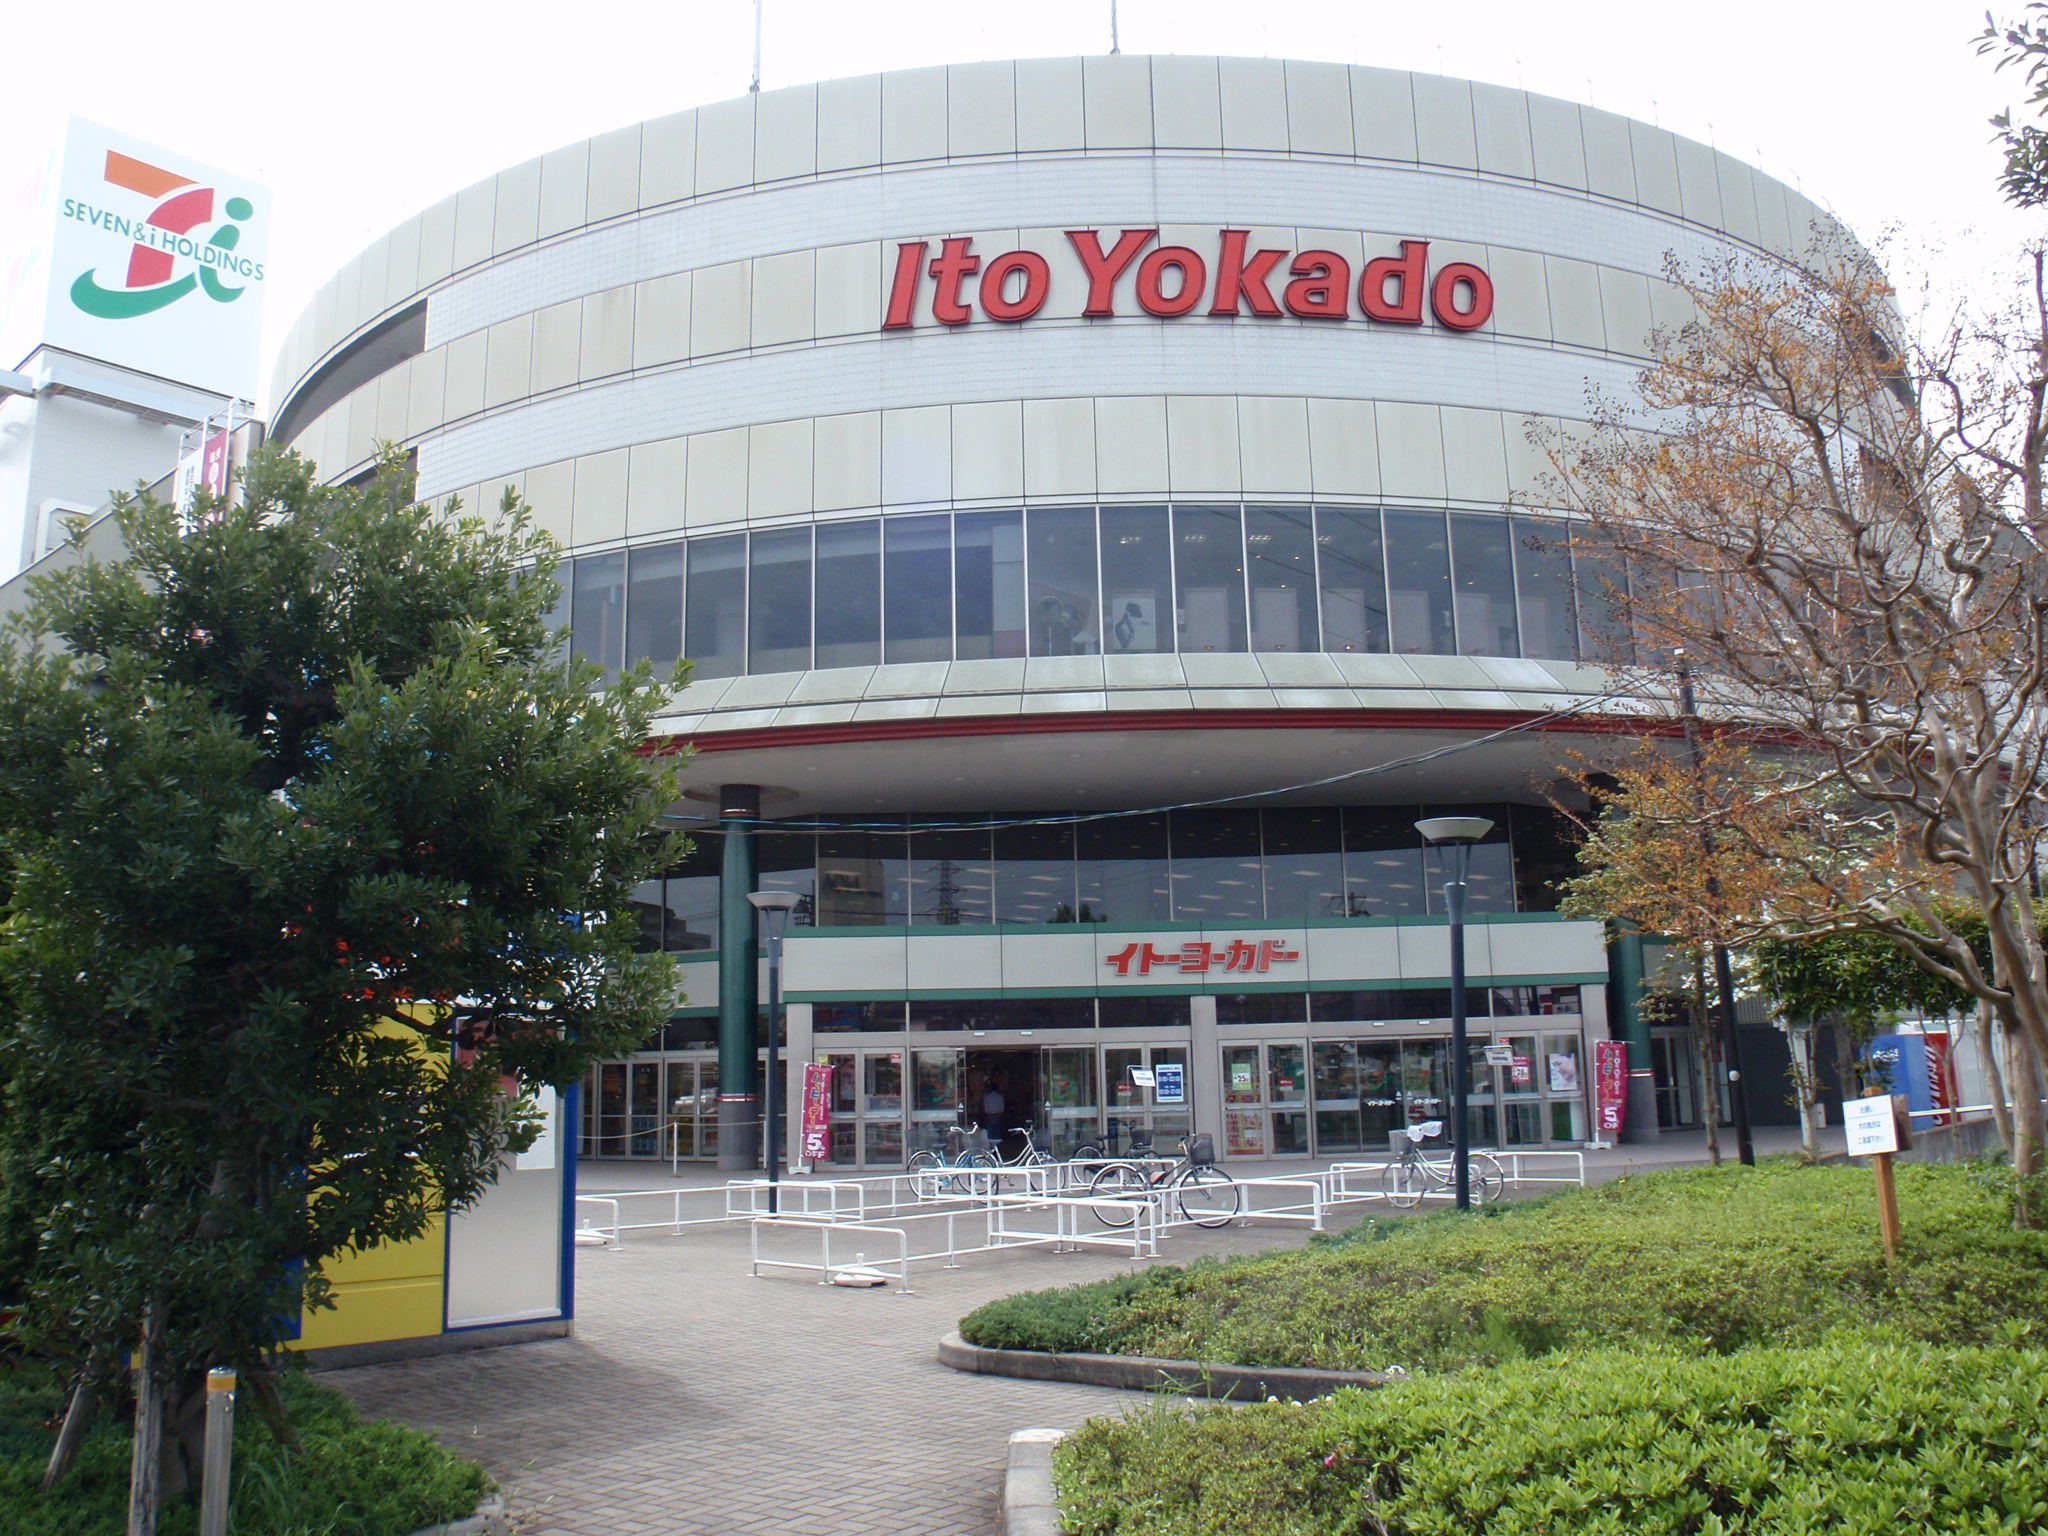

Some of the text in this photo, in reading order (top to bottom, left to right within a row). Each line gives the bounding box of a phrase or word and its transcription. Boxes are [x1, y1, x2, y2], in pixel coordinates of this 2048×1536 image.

[162, 234, 265, 281] HOLDINGS
[1105, 939, 1300, 976] イトーヨーカドー
